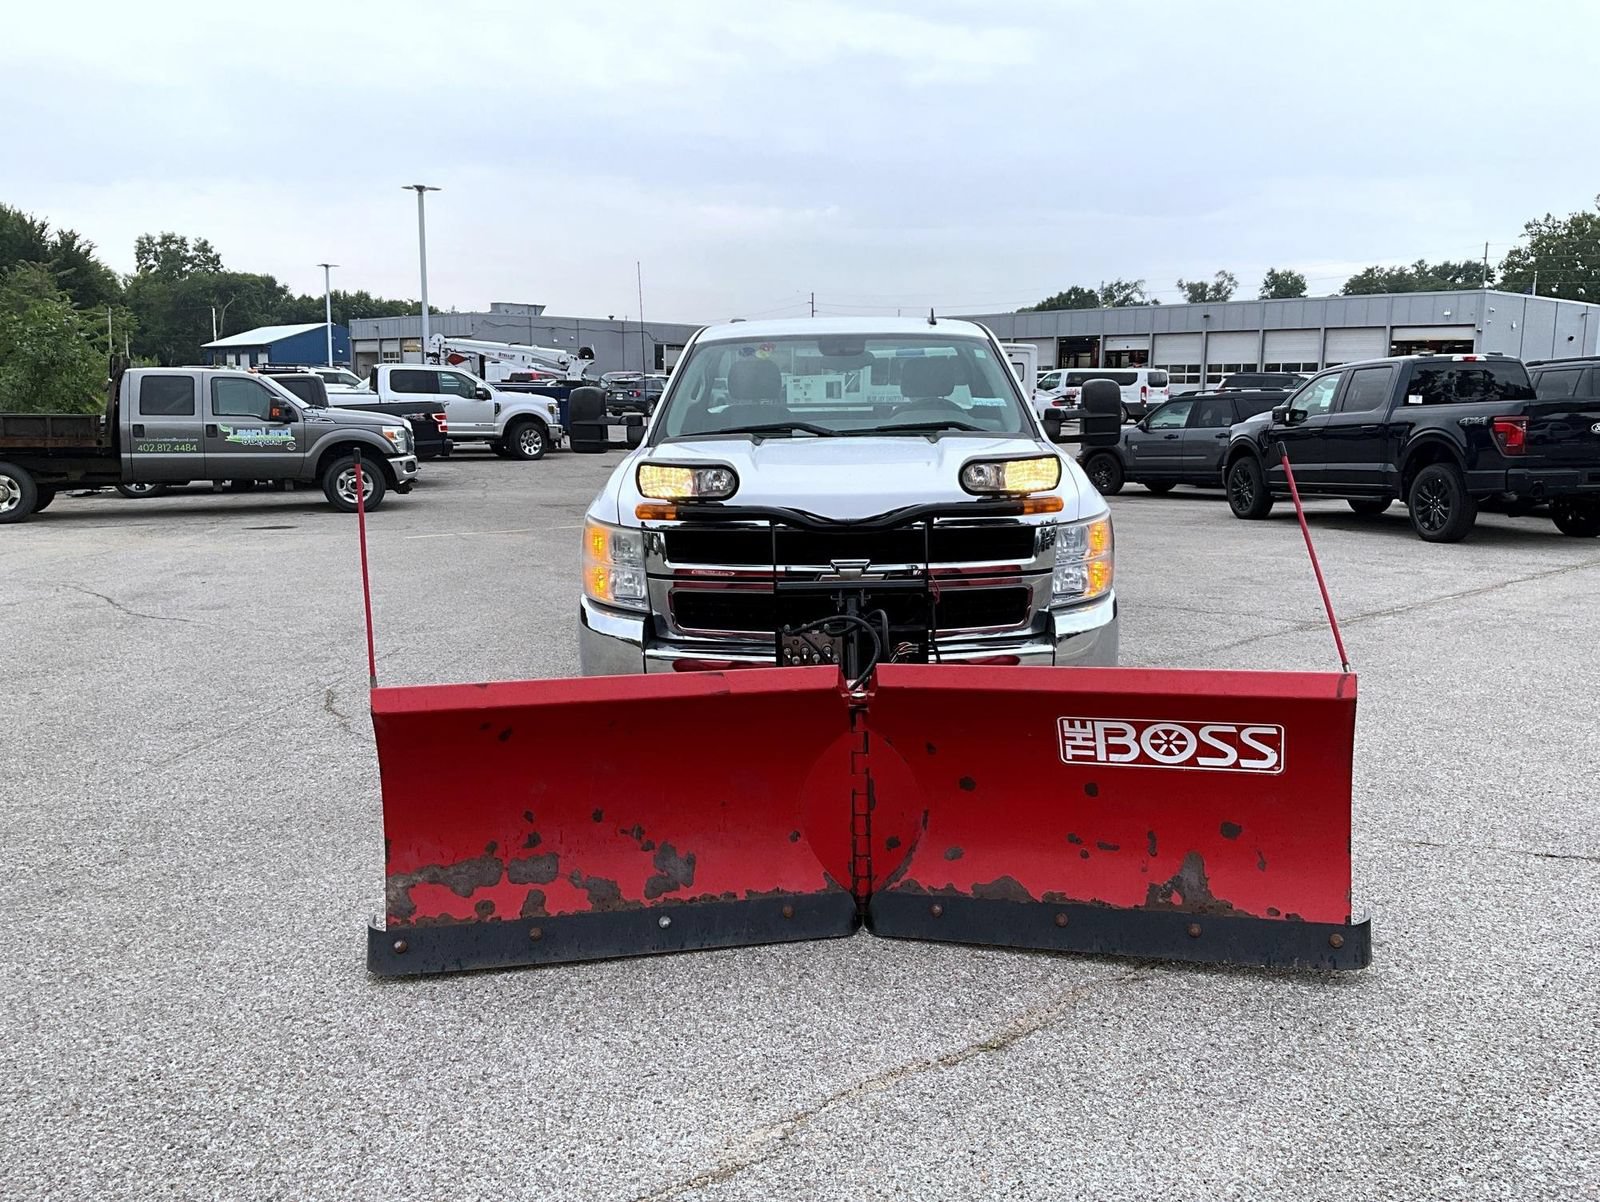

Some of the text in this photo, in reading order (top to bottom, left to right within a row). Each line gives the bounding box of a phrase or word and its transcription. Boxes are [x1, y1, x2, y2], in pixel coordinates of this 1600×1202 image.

[137, 443, 198, 452] 402.812.4484
[1062, 720, 1279, 769] THE BOSS
